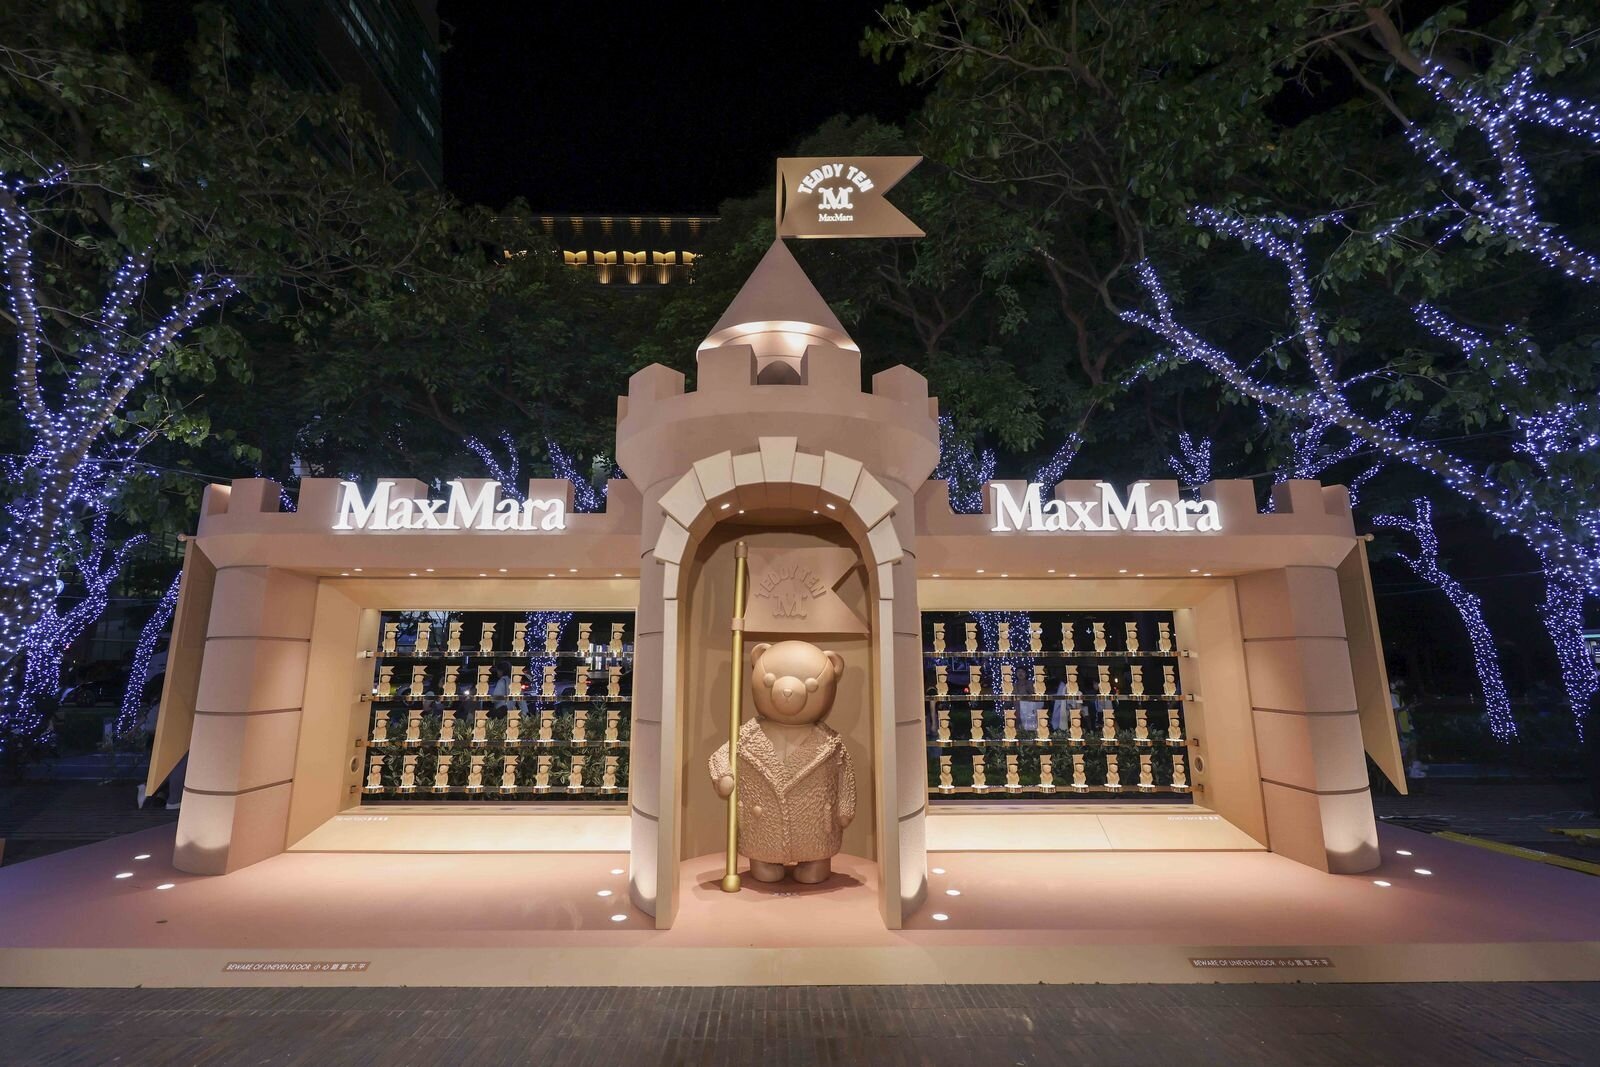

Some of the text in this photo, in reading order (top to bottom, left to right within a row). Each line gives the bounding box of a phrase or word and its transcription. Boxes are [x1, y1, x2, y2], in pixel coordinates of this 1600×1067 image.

[797, 163, 875, 194] TEDDY TEN
[818, 187, 854, 210] M
[818, 213, 854, 222] MaxMara
[332, 481, 567, 531] MaxMara
[990, 482, 1223, 532] MaxMara
[226, 963, 254, 971] BEWARE
[253, 963, 264, 971] OF
[290, 963, 312, 971] FLOOR
[1192, 959, 1219, 967] BEWARE
[1219, 959, 1228, 967] OF
[1254, 959, 1276, 967] FLOOR
